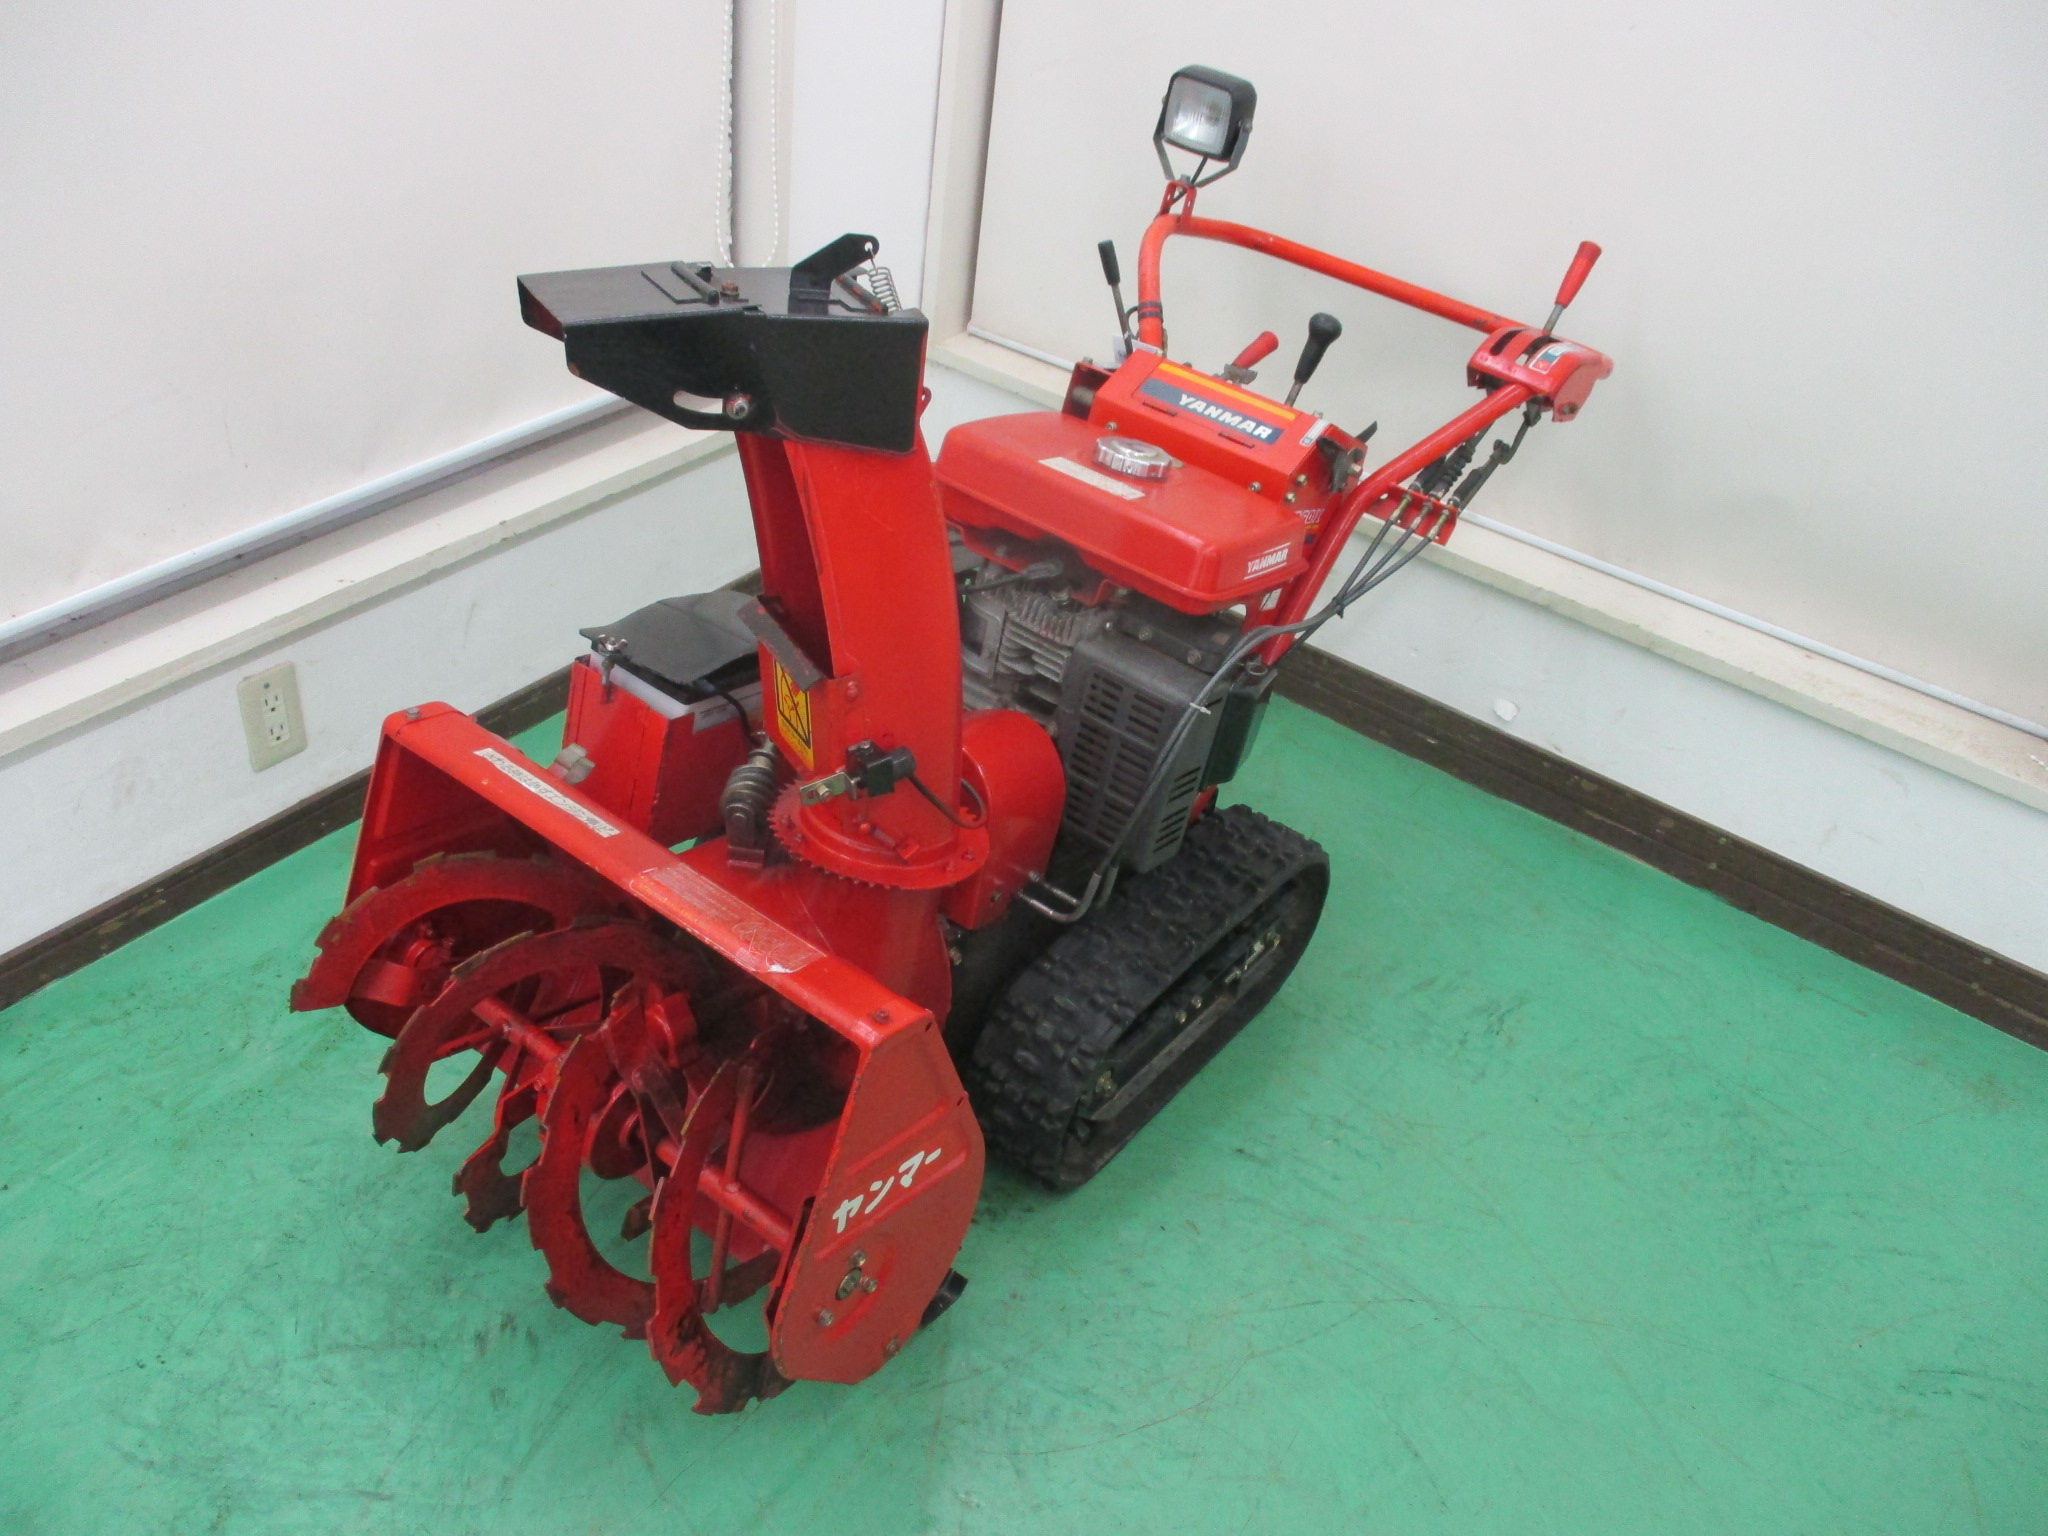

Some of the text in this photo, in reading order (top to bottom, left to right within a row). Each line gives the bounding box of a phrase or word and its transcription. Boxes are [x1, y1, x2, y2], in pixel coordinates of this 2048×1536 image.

[1178, 393, 1273, 440] YANMAR
[1247, 548, 1289, 574] YANMAR
[832, 1148, 942, 1234] ヤンマー
